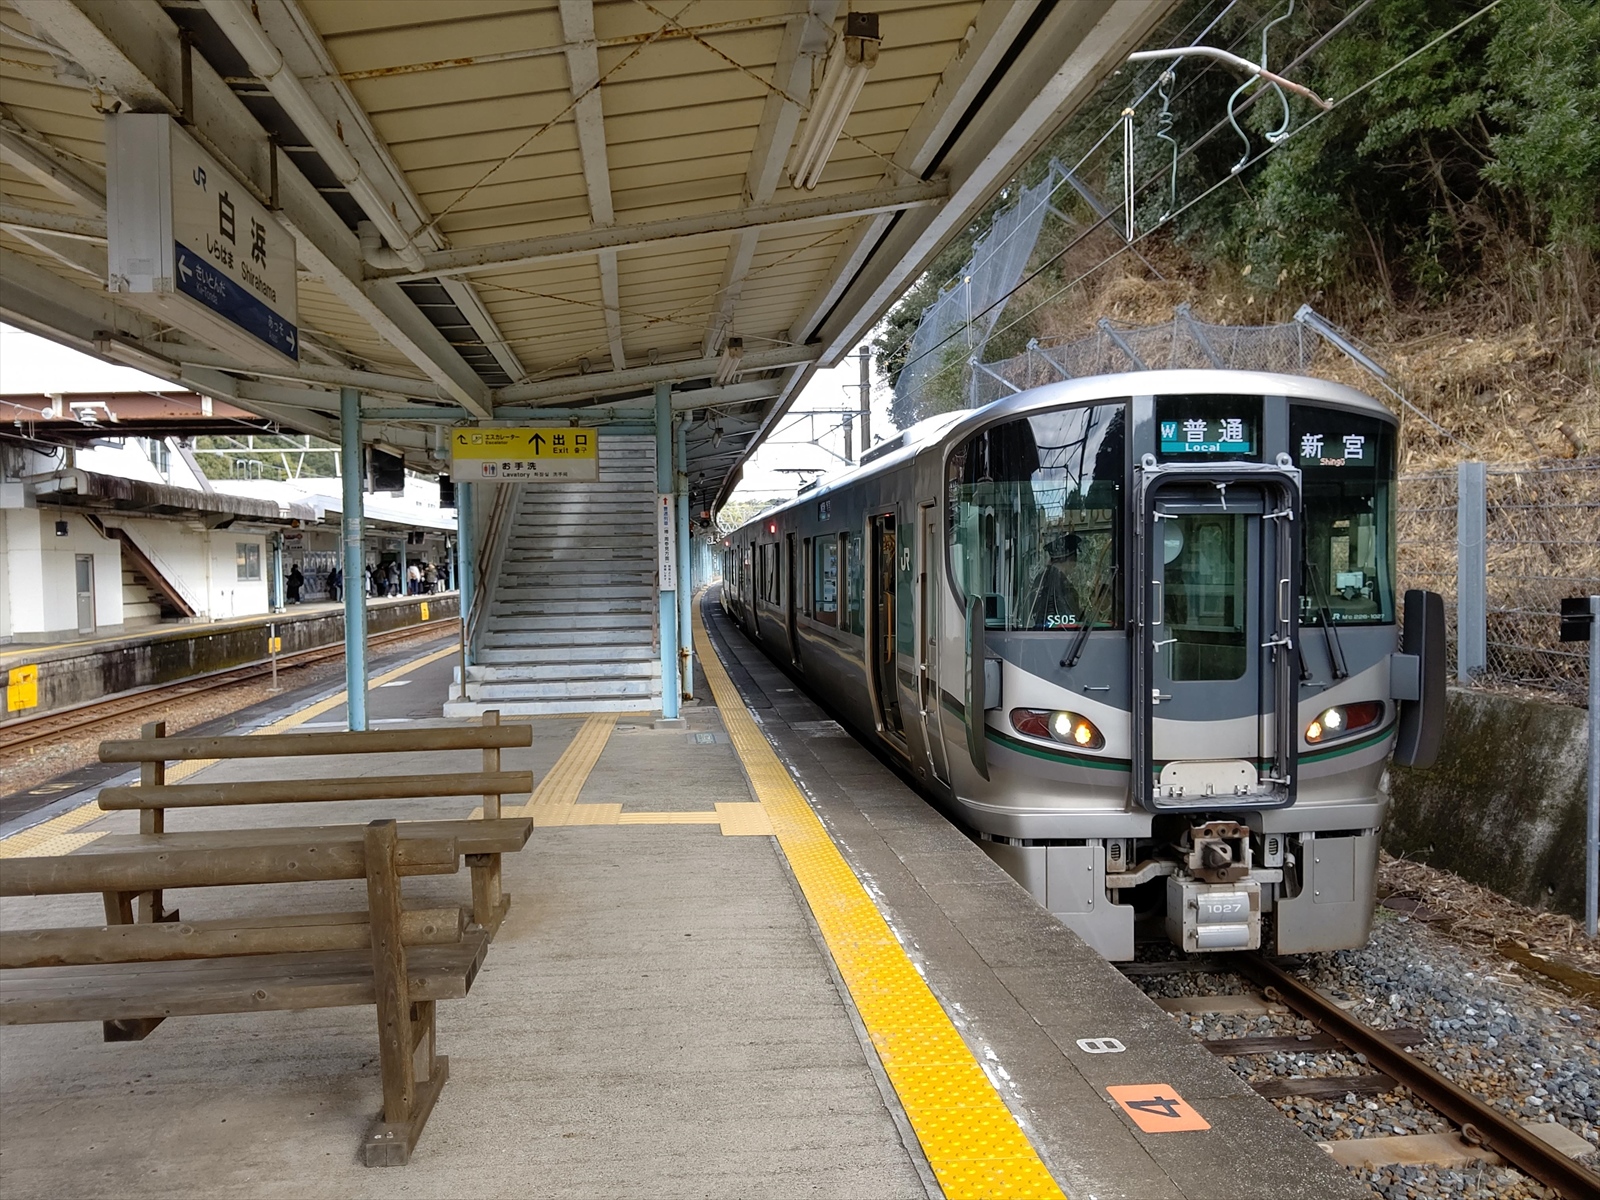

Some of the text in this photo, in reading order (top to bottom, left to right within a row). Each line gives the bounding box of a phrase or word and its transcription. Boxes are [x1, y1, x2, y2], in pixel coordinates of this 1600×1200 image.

[193, 165, 207, 192] JR
[218, 190, 267, 270] 白浜
[206, 232, 234, 270] しらはま
[195, 264, 226, 297] きいとんだ
[241, 261, 277, 303] Shirahama
[553, 434, 587, 445] 出口
[1182, 419, 1244, 443] 普通
[1185, 443, 1220, 452] Local
[1301, 433, 1365, 460] 新宮
[502, 462, 537, 470] お手洗
[901, 548, 910, 571] JR
[1047, 615, 1076, 624] SS05
[1207, 904, 1242, 913] 1027
[1125, 1096, 1182, 1118] 4
